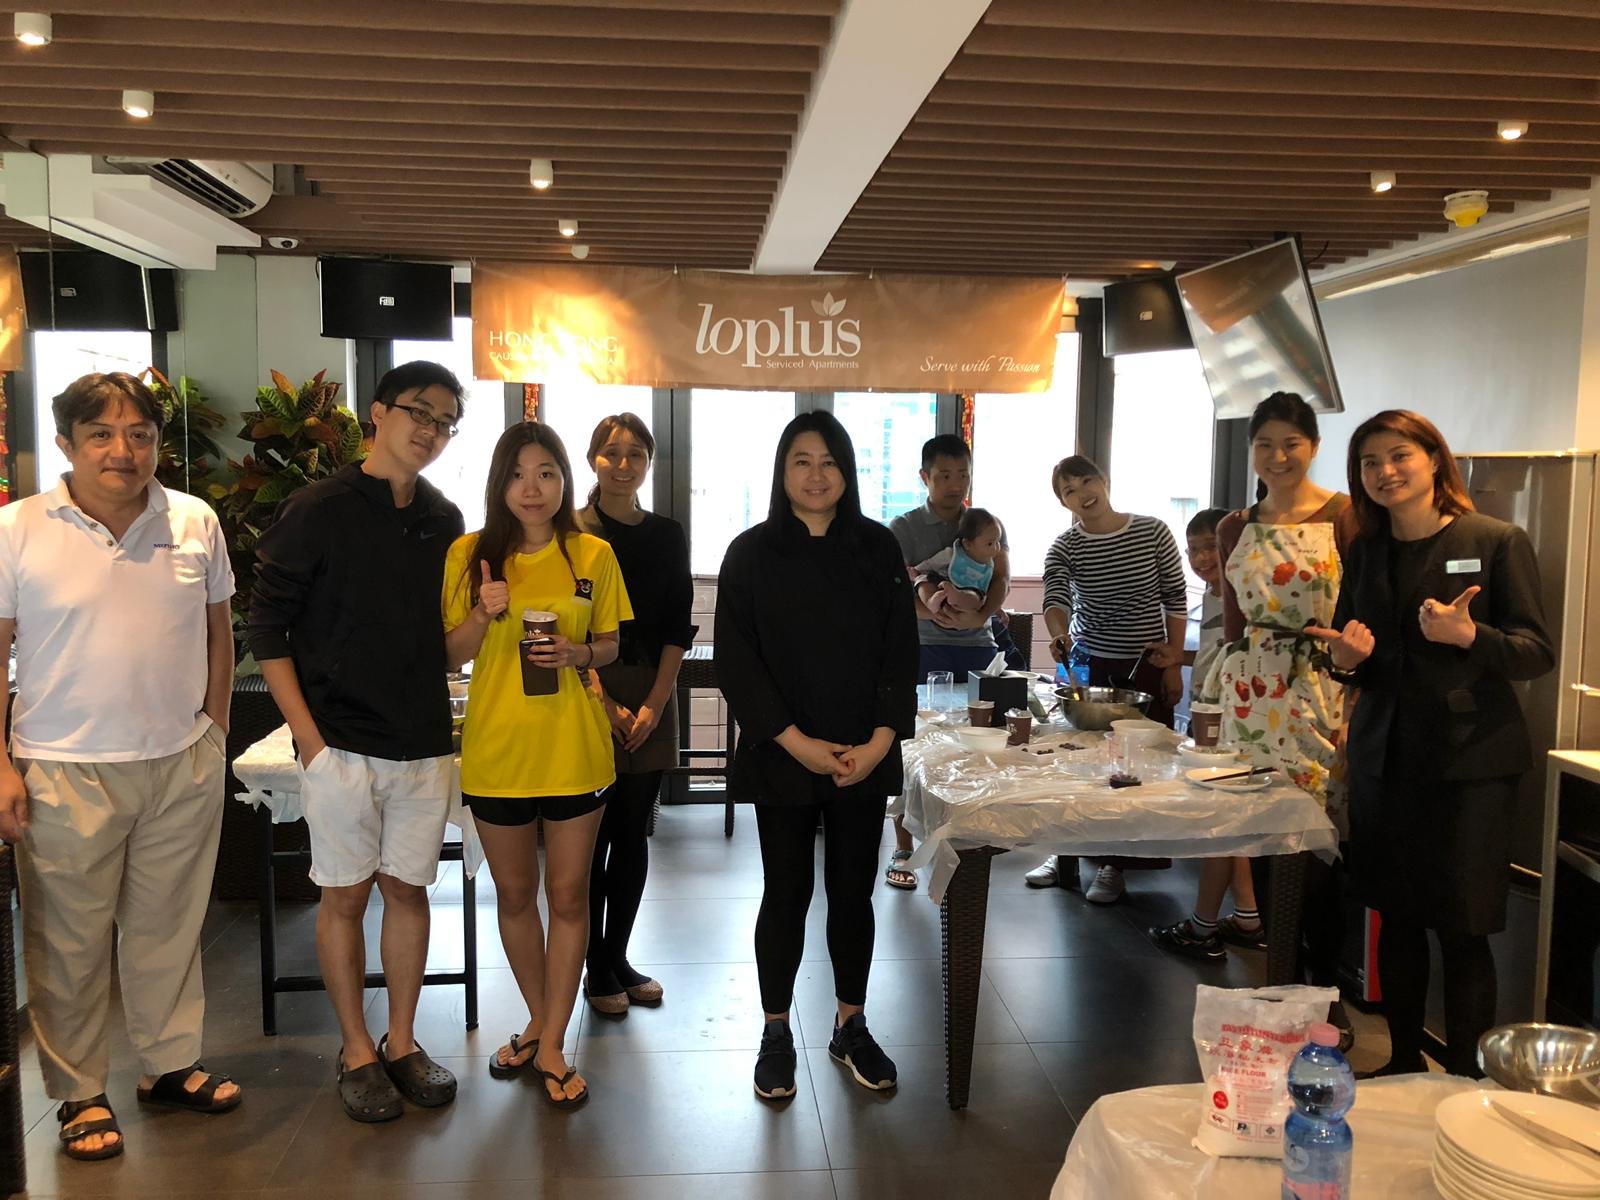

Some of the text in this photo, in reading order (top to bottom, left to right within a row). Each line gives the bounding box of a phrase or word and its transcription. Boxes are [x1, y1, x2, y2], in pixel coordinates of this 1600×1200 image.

[696, 303, 861, 367] loplus
[766, 359, 859, 371] Serviced Apartments
[920, 356, 958, 372] Serve
[961, 355, 995, 372] with
